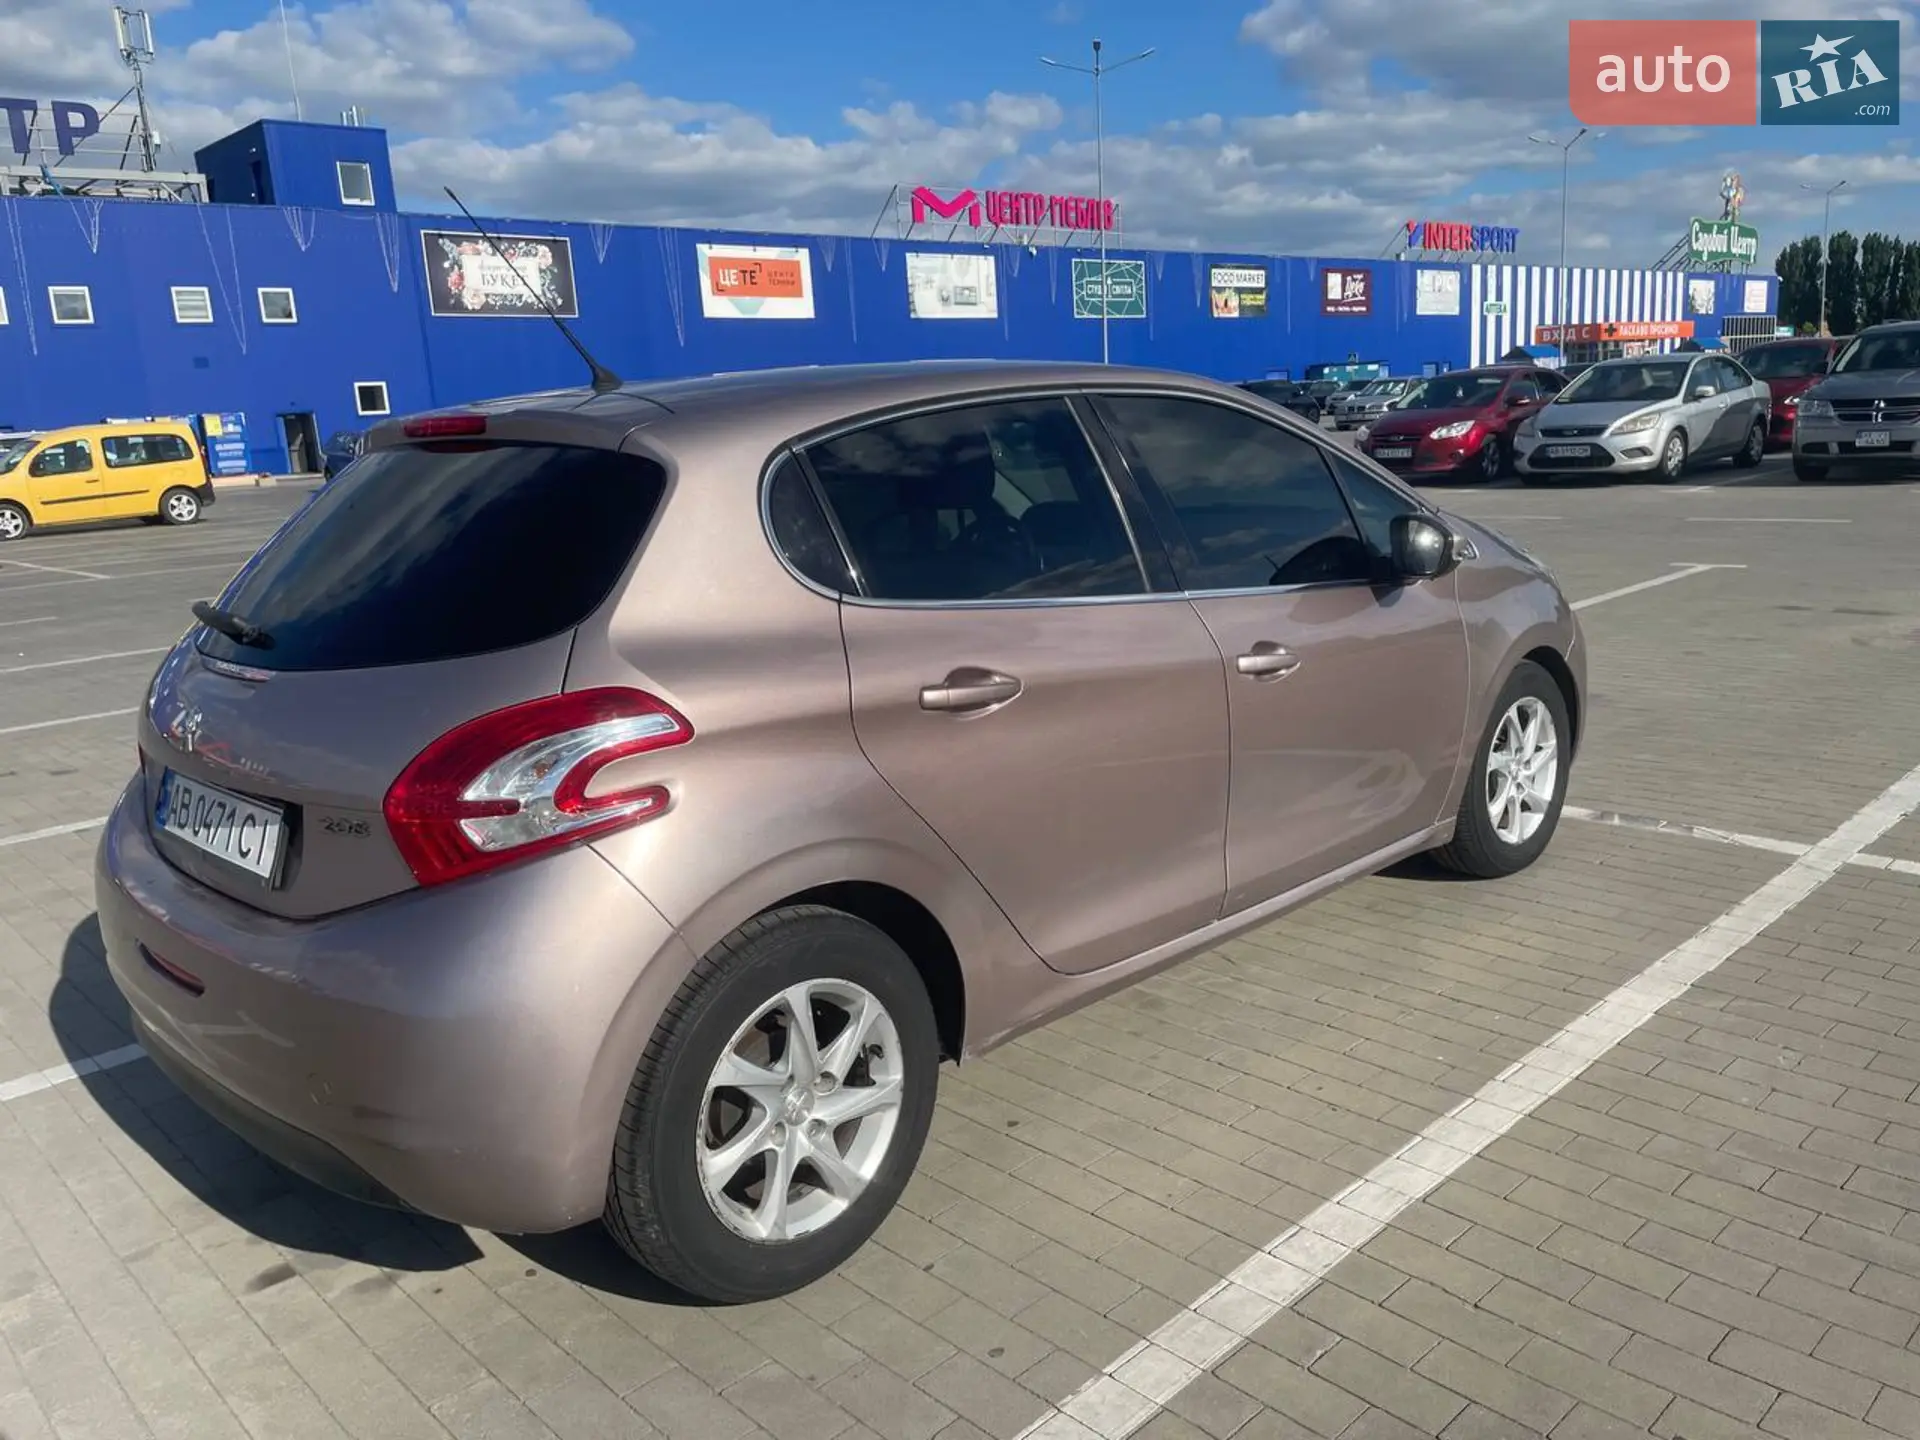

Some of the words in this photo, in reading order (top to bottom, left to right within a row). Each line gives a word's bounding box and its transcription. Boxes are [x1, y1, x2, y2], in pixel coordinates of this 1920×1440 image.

[986, 191, 1045, 228] ЦЕНТР
[1050, 196, 1114, 230] МЕБЛІВ
[1423, 222, 1519, 252] INTERSPORT
[1235, 272, 1264, 284] MARKET
[1543, 329, 1576, 341] ВХД
